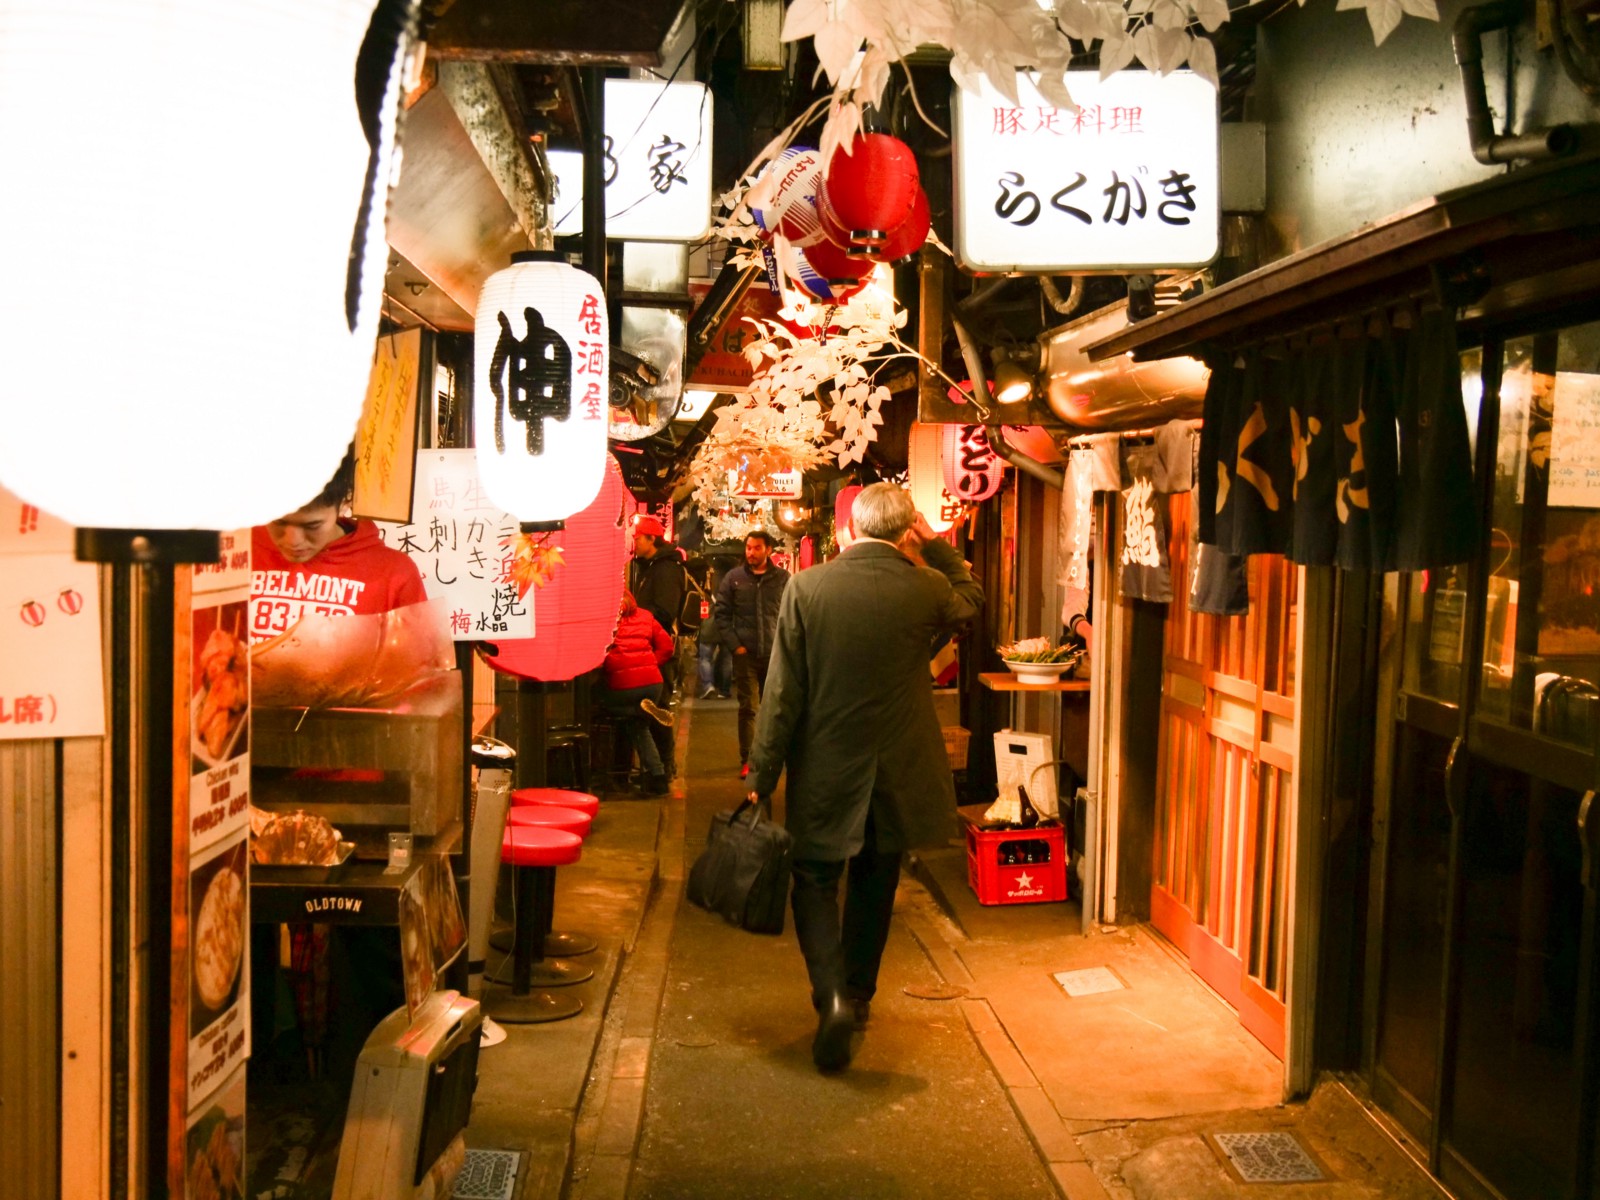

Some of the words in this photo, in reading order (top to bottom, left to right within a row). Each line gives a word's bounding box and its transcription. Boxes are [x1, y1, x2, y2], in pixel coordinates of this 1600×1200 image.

[992, 104, 1146, 136] 豚足料理
[994, 165, 1197, 227] らくがき
[576, 294, 604, 420] 居酒屋
[427, 477, 458, 585] 馬刺し
[463, 477, 495, 579] 生かき
[251, 570, 366, 606] BELMONT
[450, 608, 509, 635] 梅水晶
[305, 896, 363, 914] OLDTOWN
